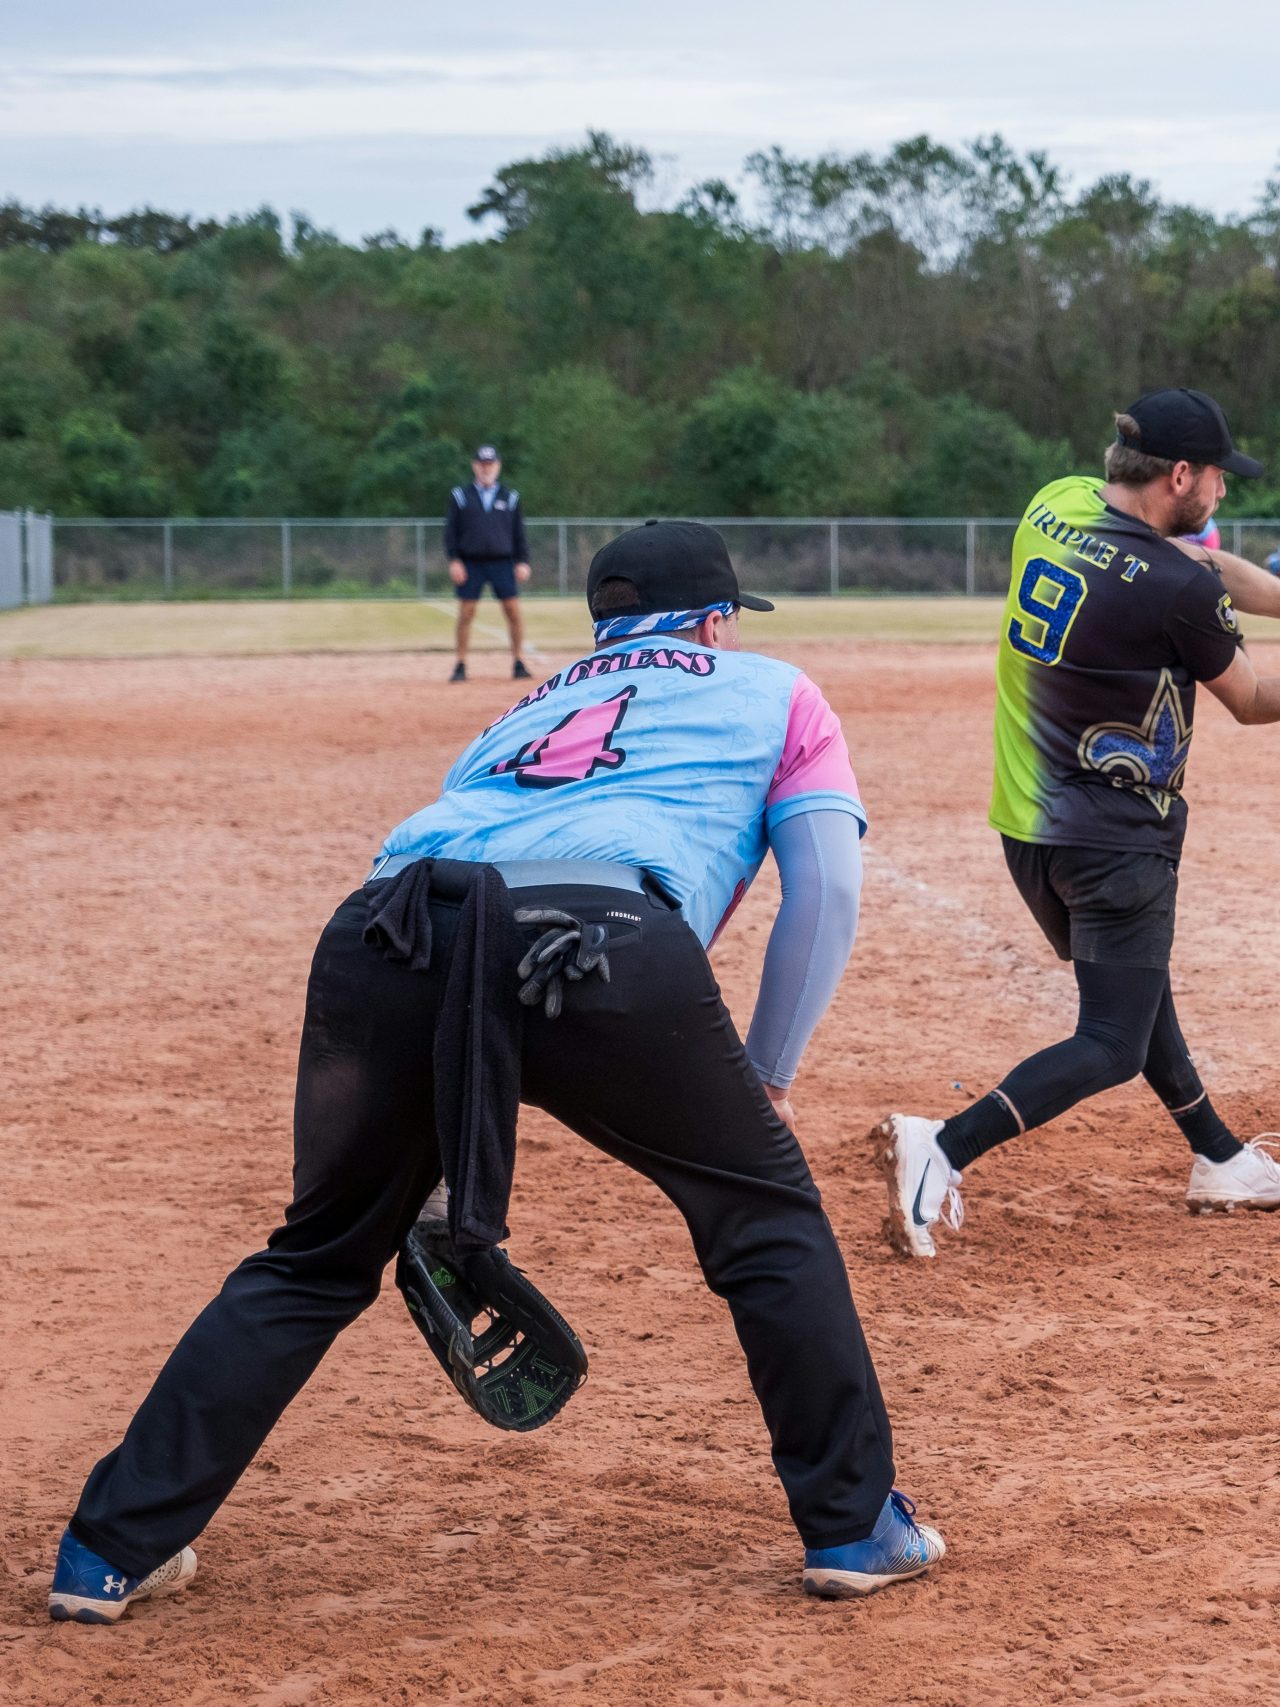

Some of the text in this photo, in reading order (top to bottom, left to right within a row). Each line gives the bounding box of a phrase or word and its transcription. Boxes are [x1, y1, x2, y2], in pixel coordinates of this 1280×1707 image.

[1027, 504, 1149, 583] TRIPLE T
[1008, 554, 1088, 666] 9
[565, 648, 716, 686] ORLEANS
[489, 685, 637, 789] 4
